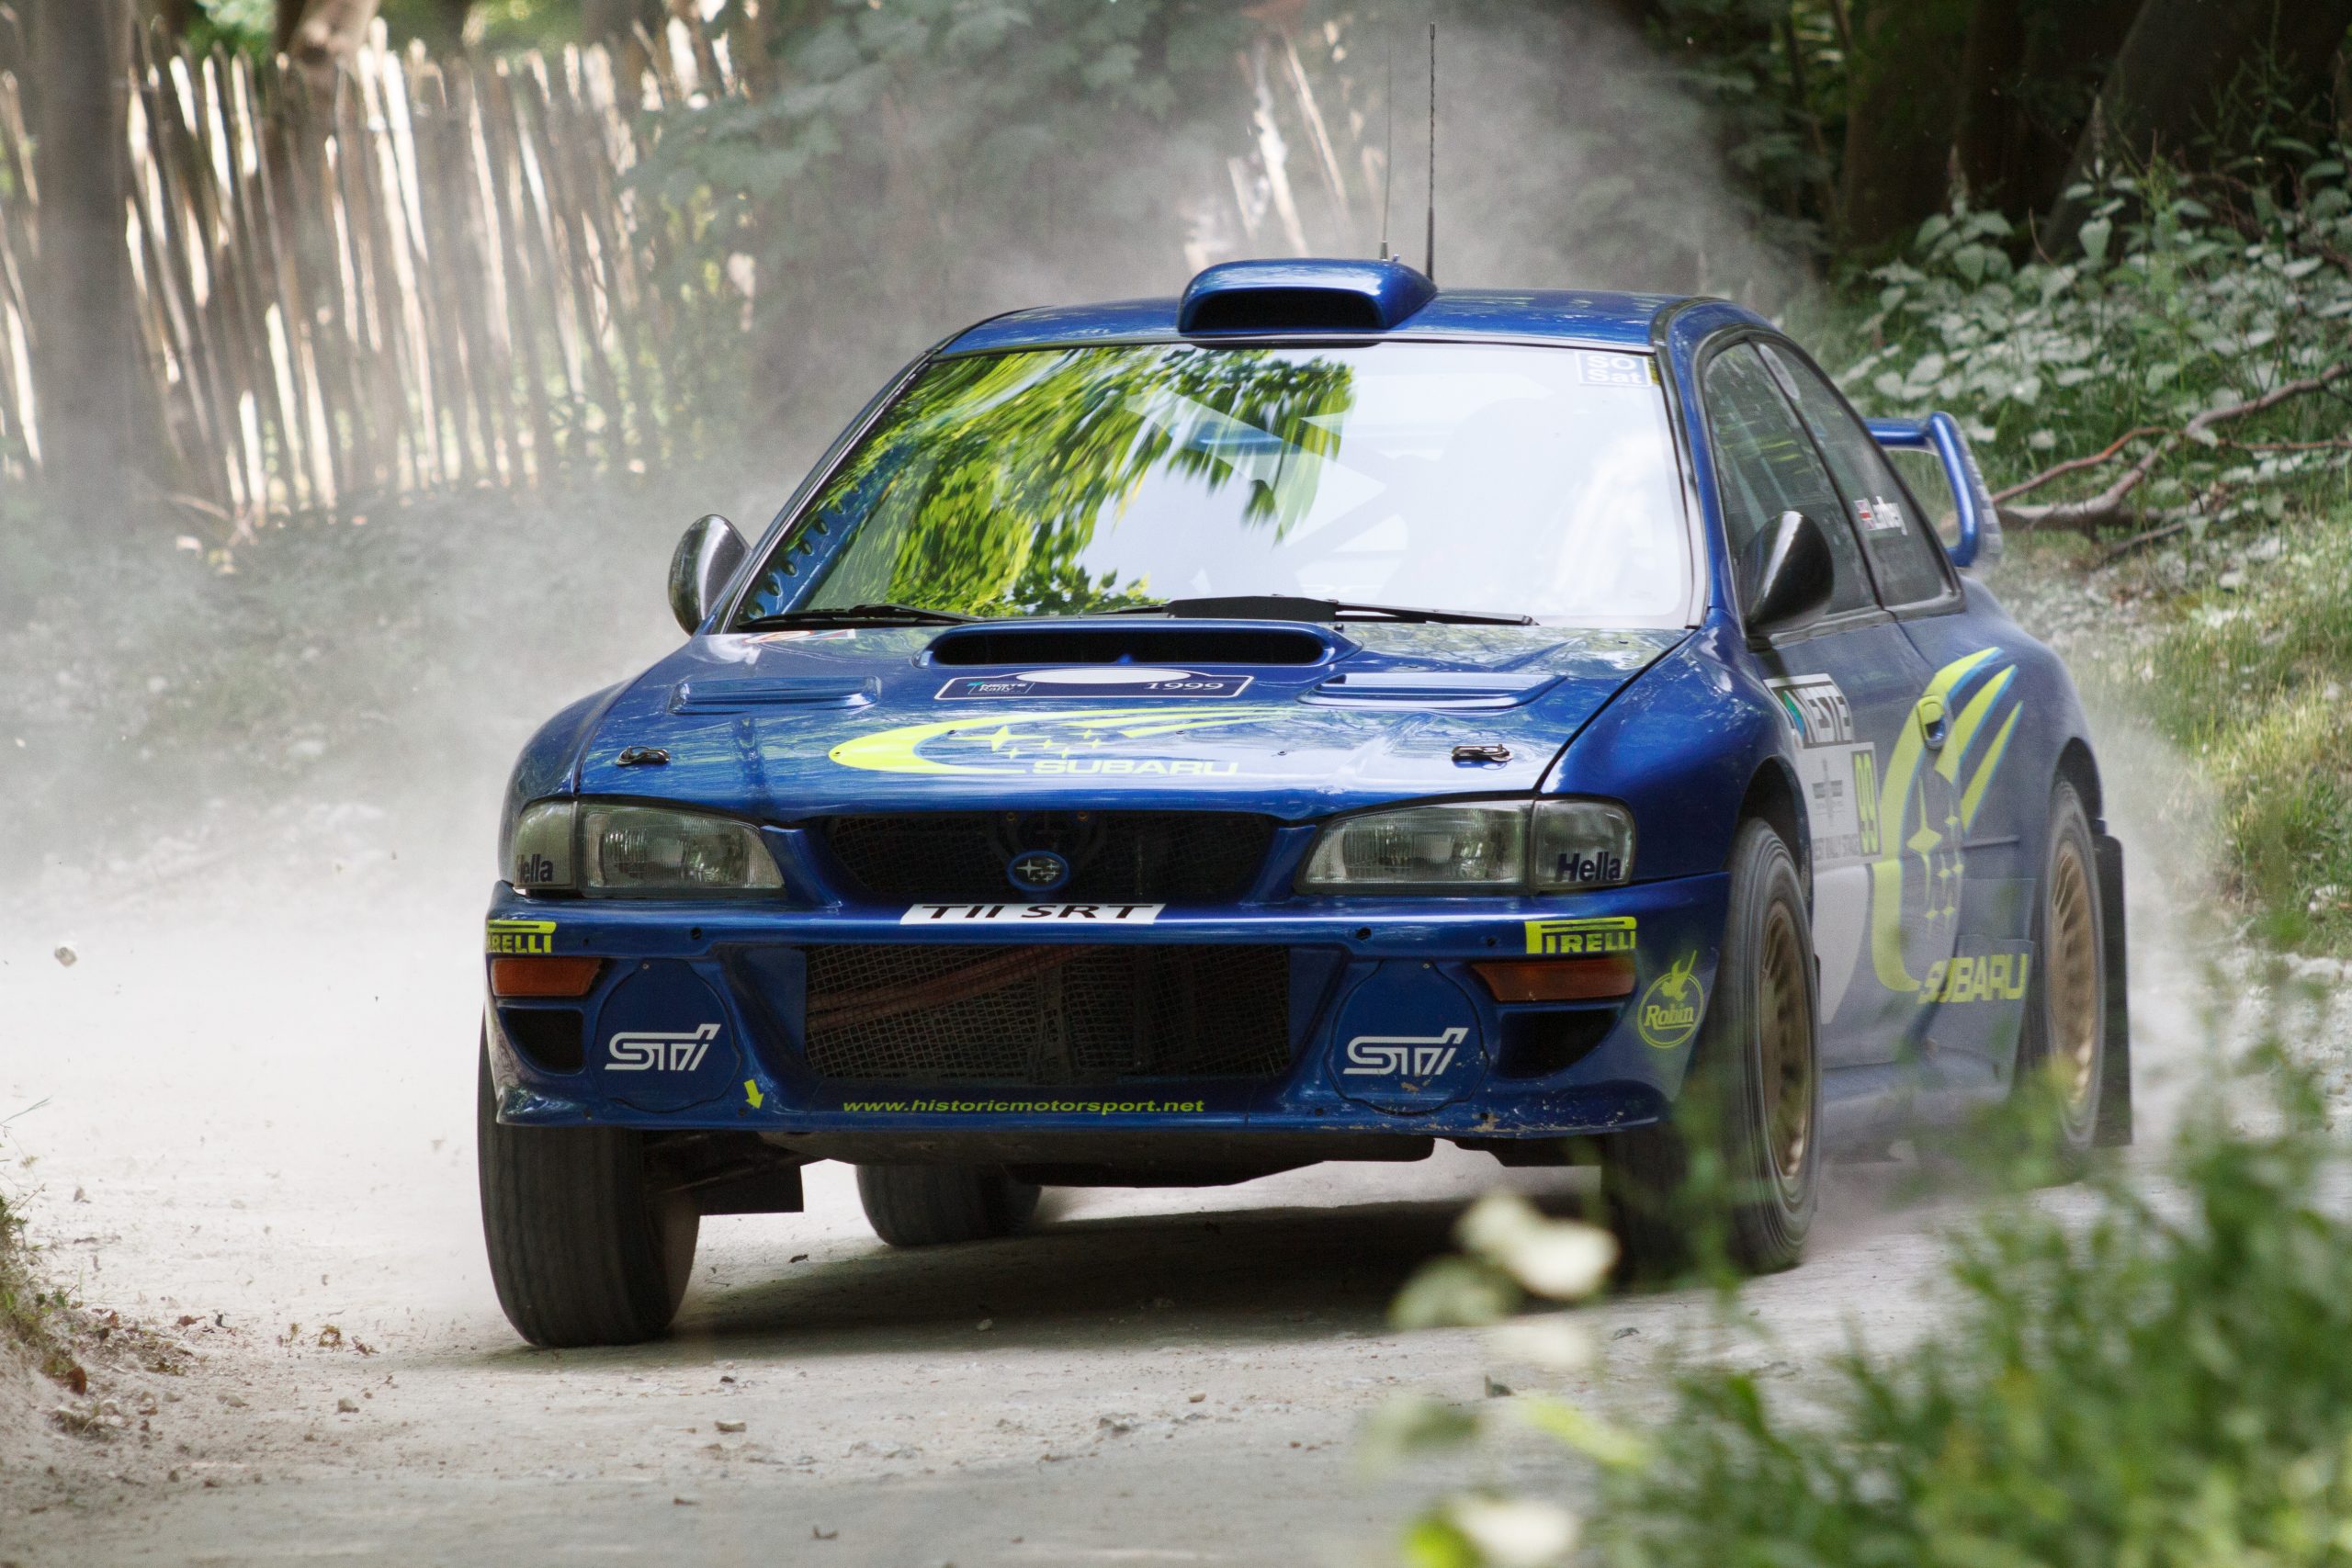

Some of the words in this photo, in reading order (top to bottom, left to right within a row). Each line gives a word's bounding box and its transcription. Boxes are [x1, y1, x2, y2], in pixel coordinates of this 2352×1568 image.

[1587, 355, 1636, 370] SO
[1587, 369, 1643, 384] Sat
[1144, 682, 1224, 691] 1999
[1032, 759, 1239, 776] SUBARU
[1557, 852, 1622, 883] Hella
[1022, 905, 1154, 919] SRT
[1524, 916, 1638, 954] PIRELLI
[1917, 953, 2030, 1004] SUBARU
[1644, 1005, 1694, 1030] Robin
[842, 1100, 1204, 1115] www.historicmotorsport.net
